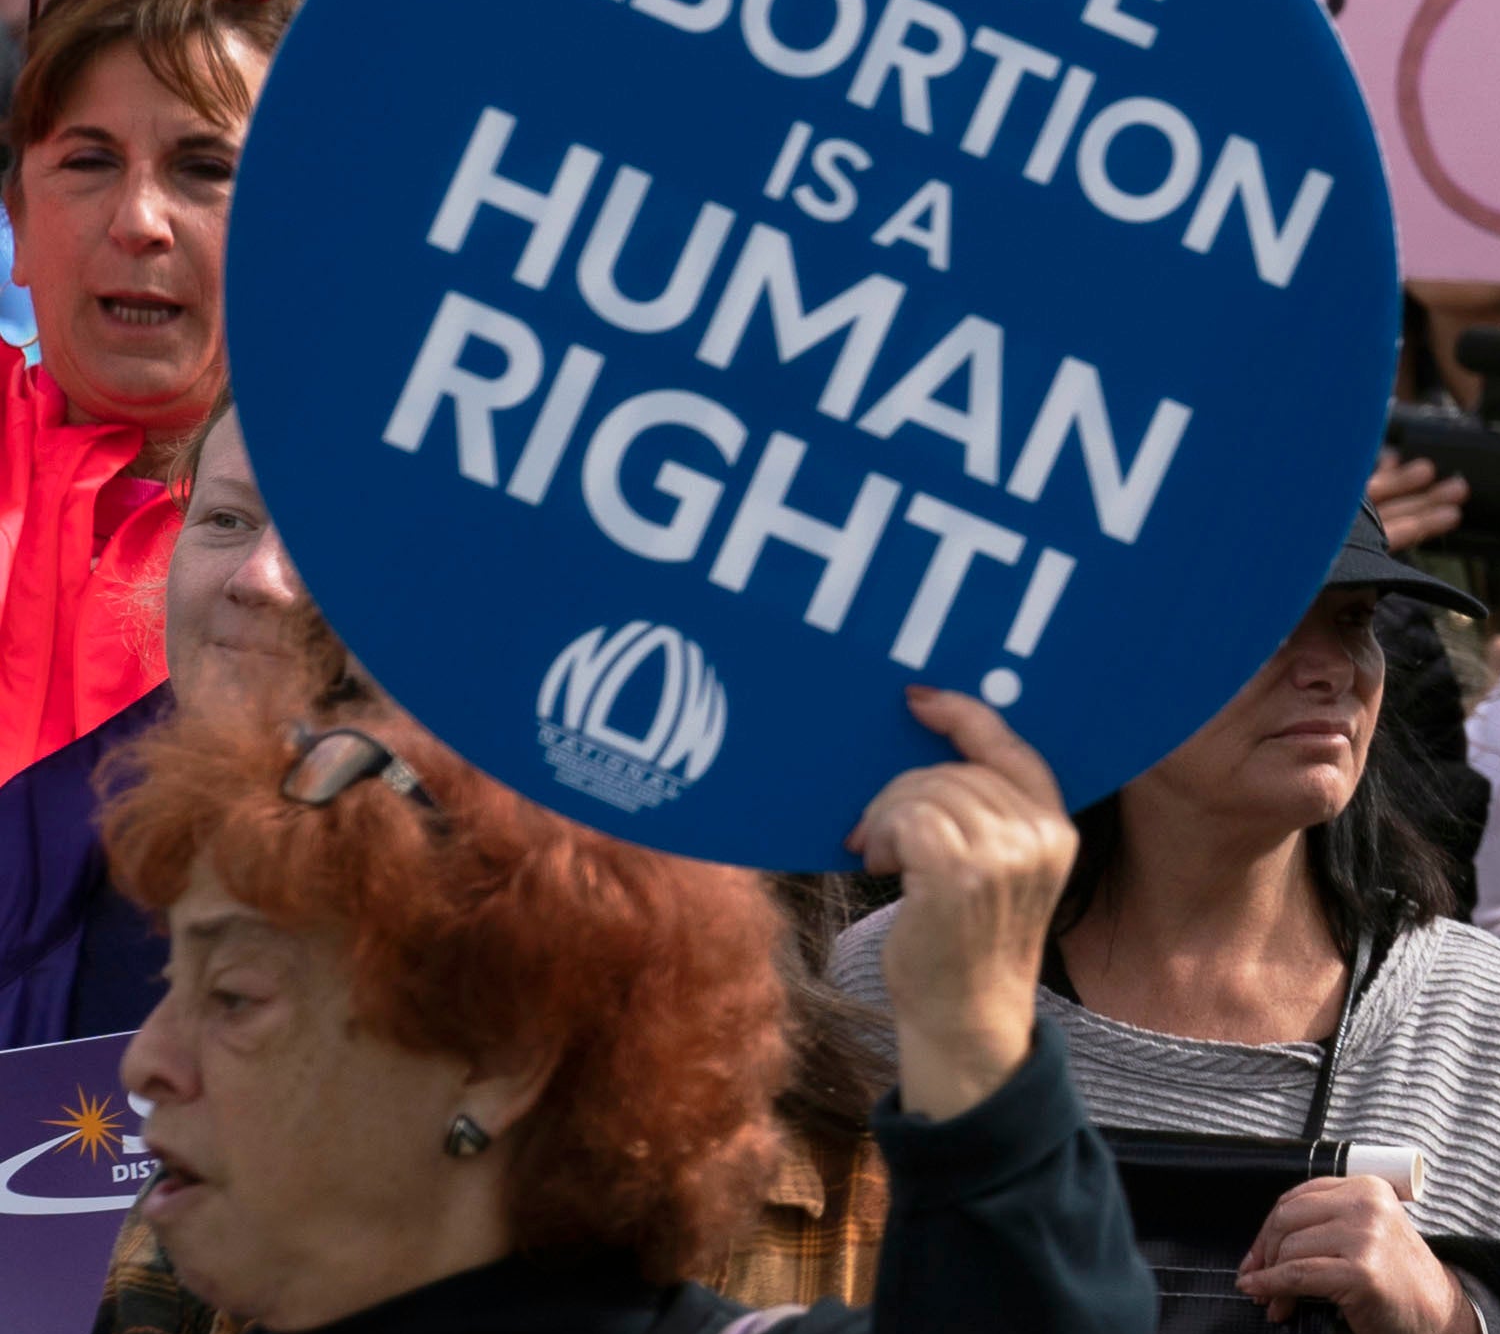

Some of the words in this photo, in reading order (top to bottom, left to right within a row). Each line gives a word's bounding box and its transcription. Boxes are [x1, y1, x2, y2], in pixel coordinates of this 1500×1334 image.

[763, 121, 874, 224] IS
[871, 179, 955, 271] A
[425, 105, 1194, 546] HUMAN
[380, 290, 1078, 708] RIGHT!
[535, 619, 729, 784] NOW
[537, 722, 681, 801] NATIONAL
